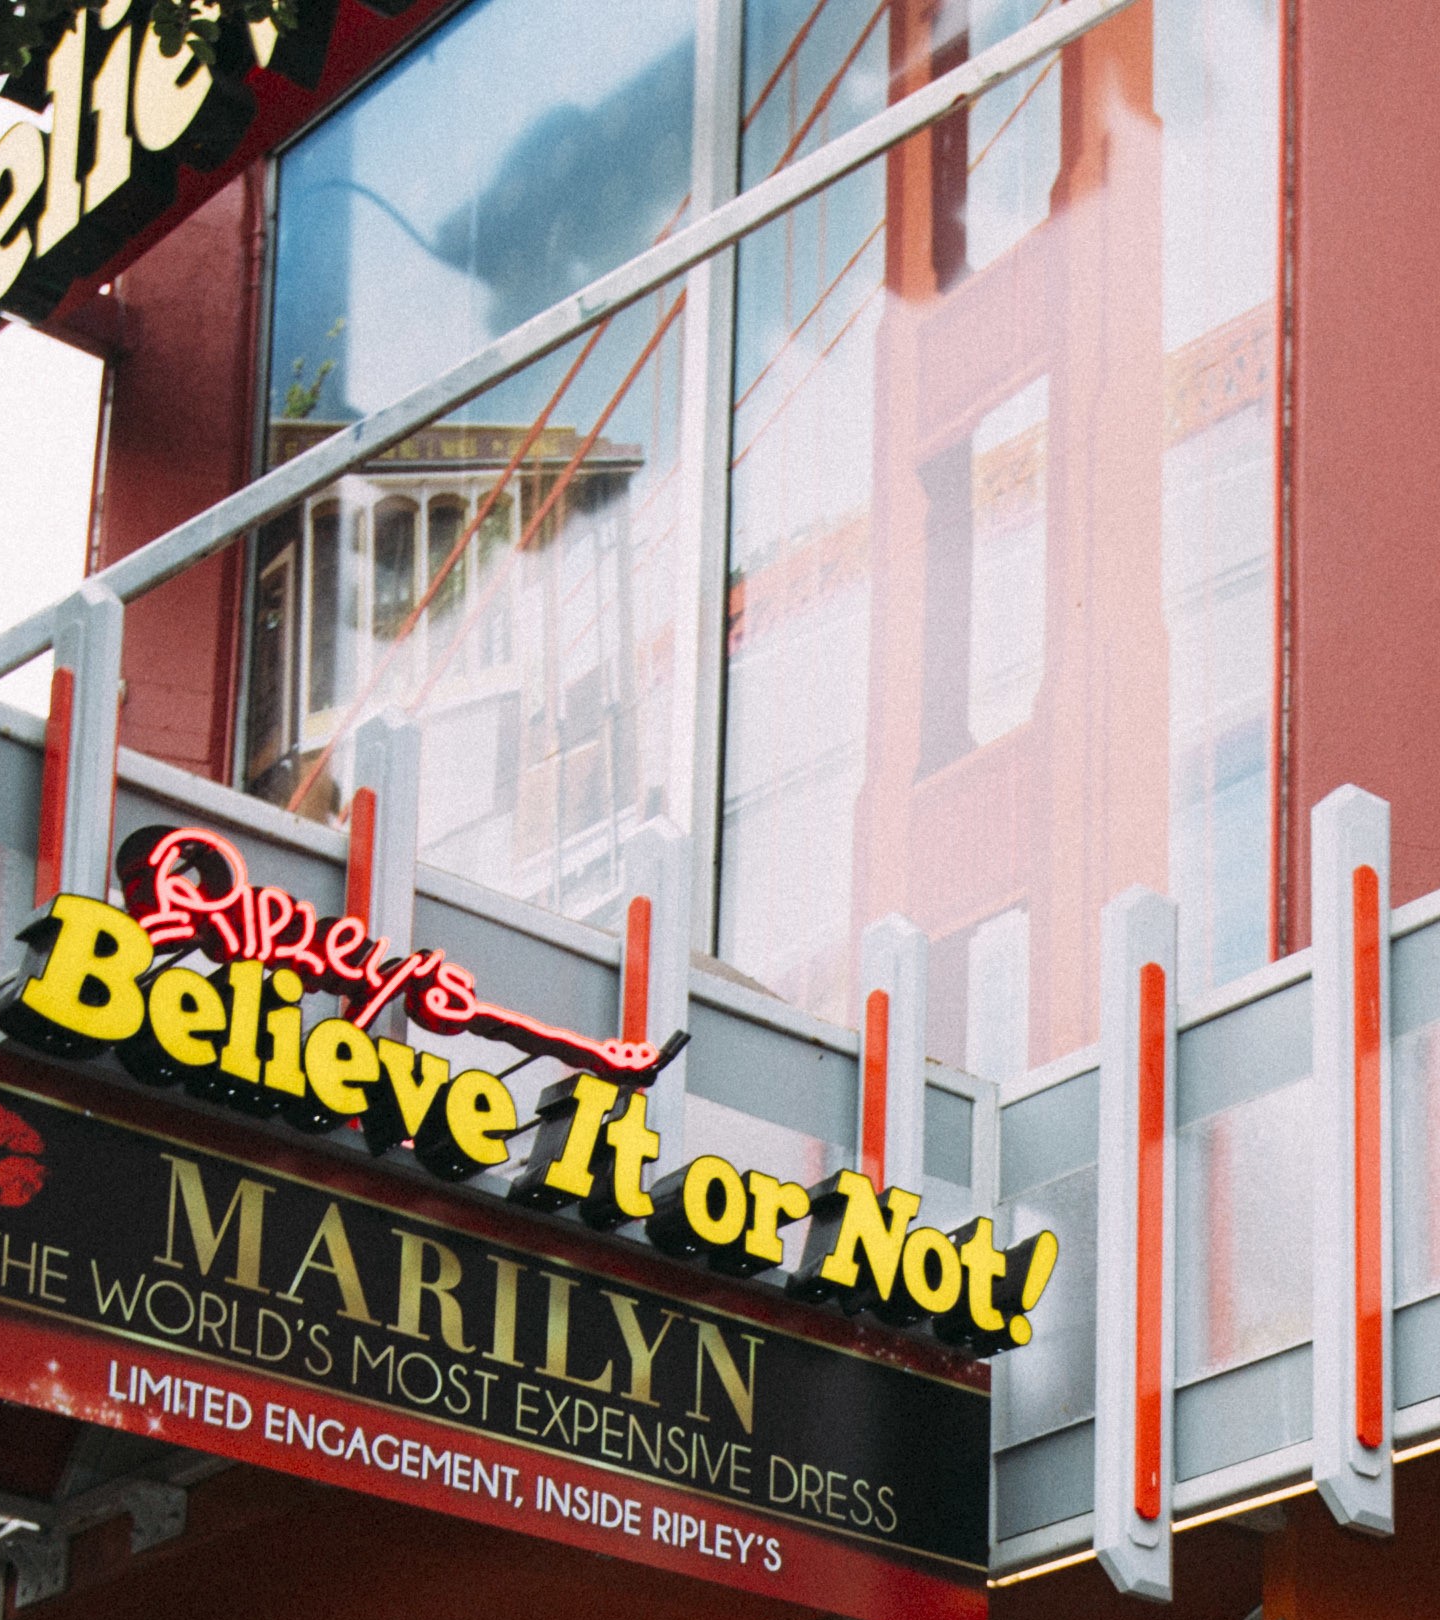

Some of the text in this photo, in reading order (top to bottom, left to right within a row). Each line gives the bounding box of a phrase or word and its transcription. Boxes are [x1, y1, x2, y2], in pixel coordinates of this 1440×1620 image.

[21, 892, 1059, 1347] Believe It or Not!
[90, 1258, 334, 1377] WORLD'S
[351, 1334, 499, 1421] MOST
[515, 1382, 753, 1496] EXPENSIVE
[768, 1454, 898, 1534] DRESS
[152, 1152, 765, 1435] MARILYN
[108, 1360, 784, 1573] LIMITED ENGAGEMENT, INSIDE RIPLEY'S
